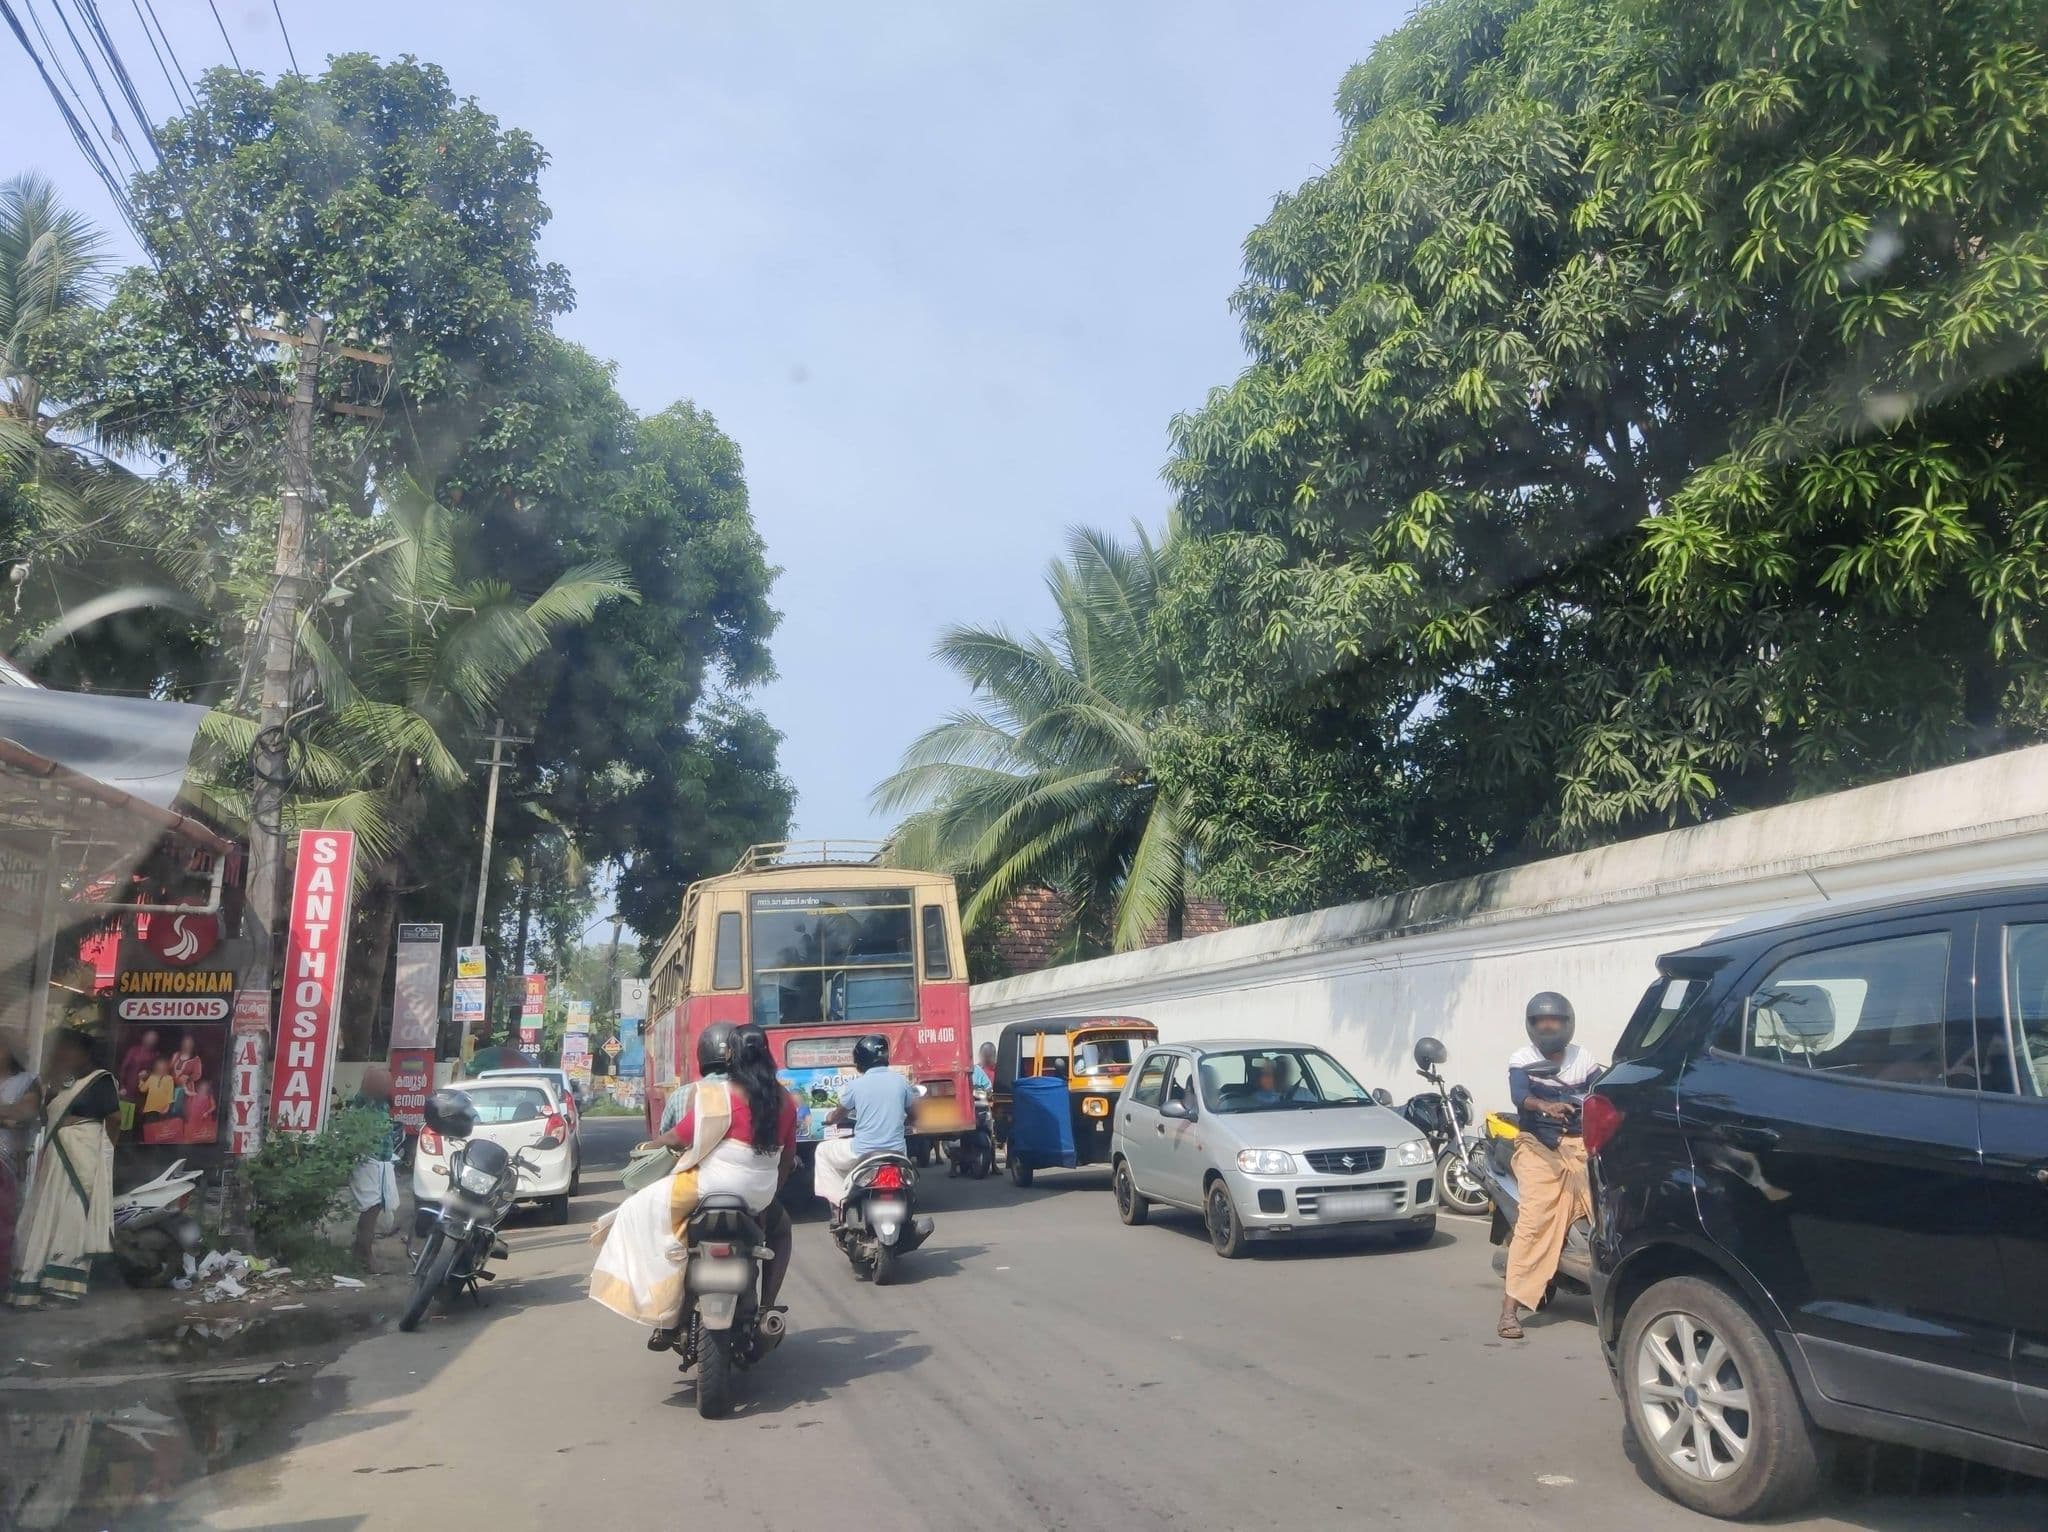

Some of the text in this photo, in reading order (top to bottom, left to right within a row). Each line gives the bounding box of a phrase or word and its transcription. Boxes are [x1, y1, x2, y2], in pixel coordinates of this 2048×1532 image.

[120, 971, 233, 993] SANTHOSHAM
[277, 837, 338, 1128] SANTHOSHAM
[126, 1002, 221, 1017] FASHIONS
